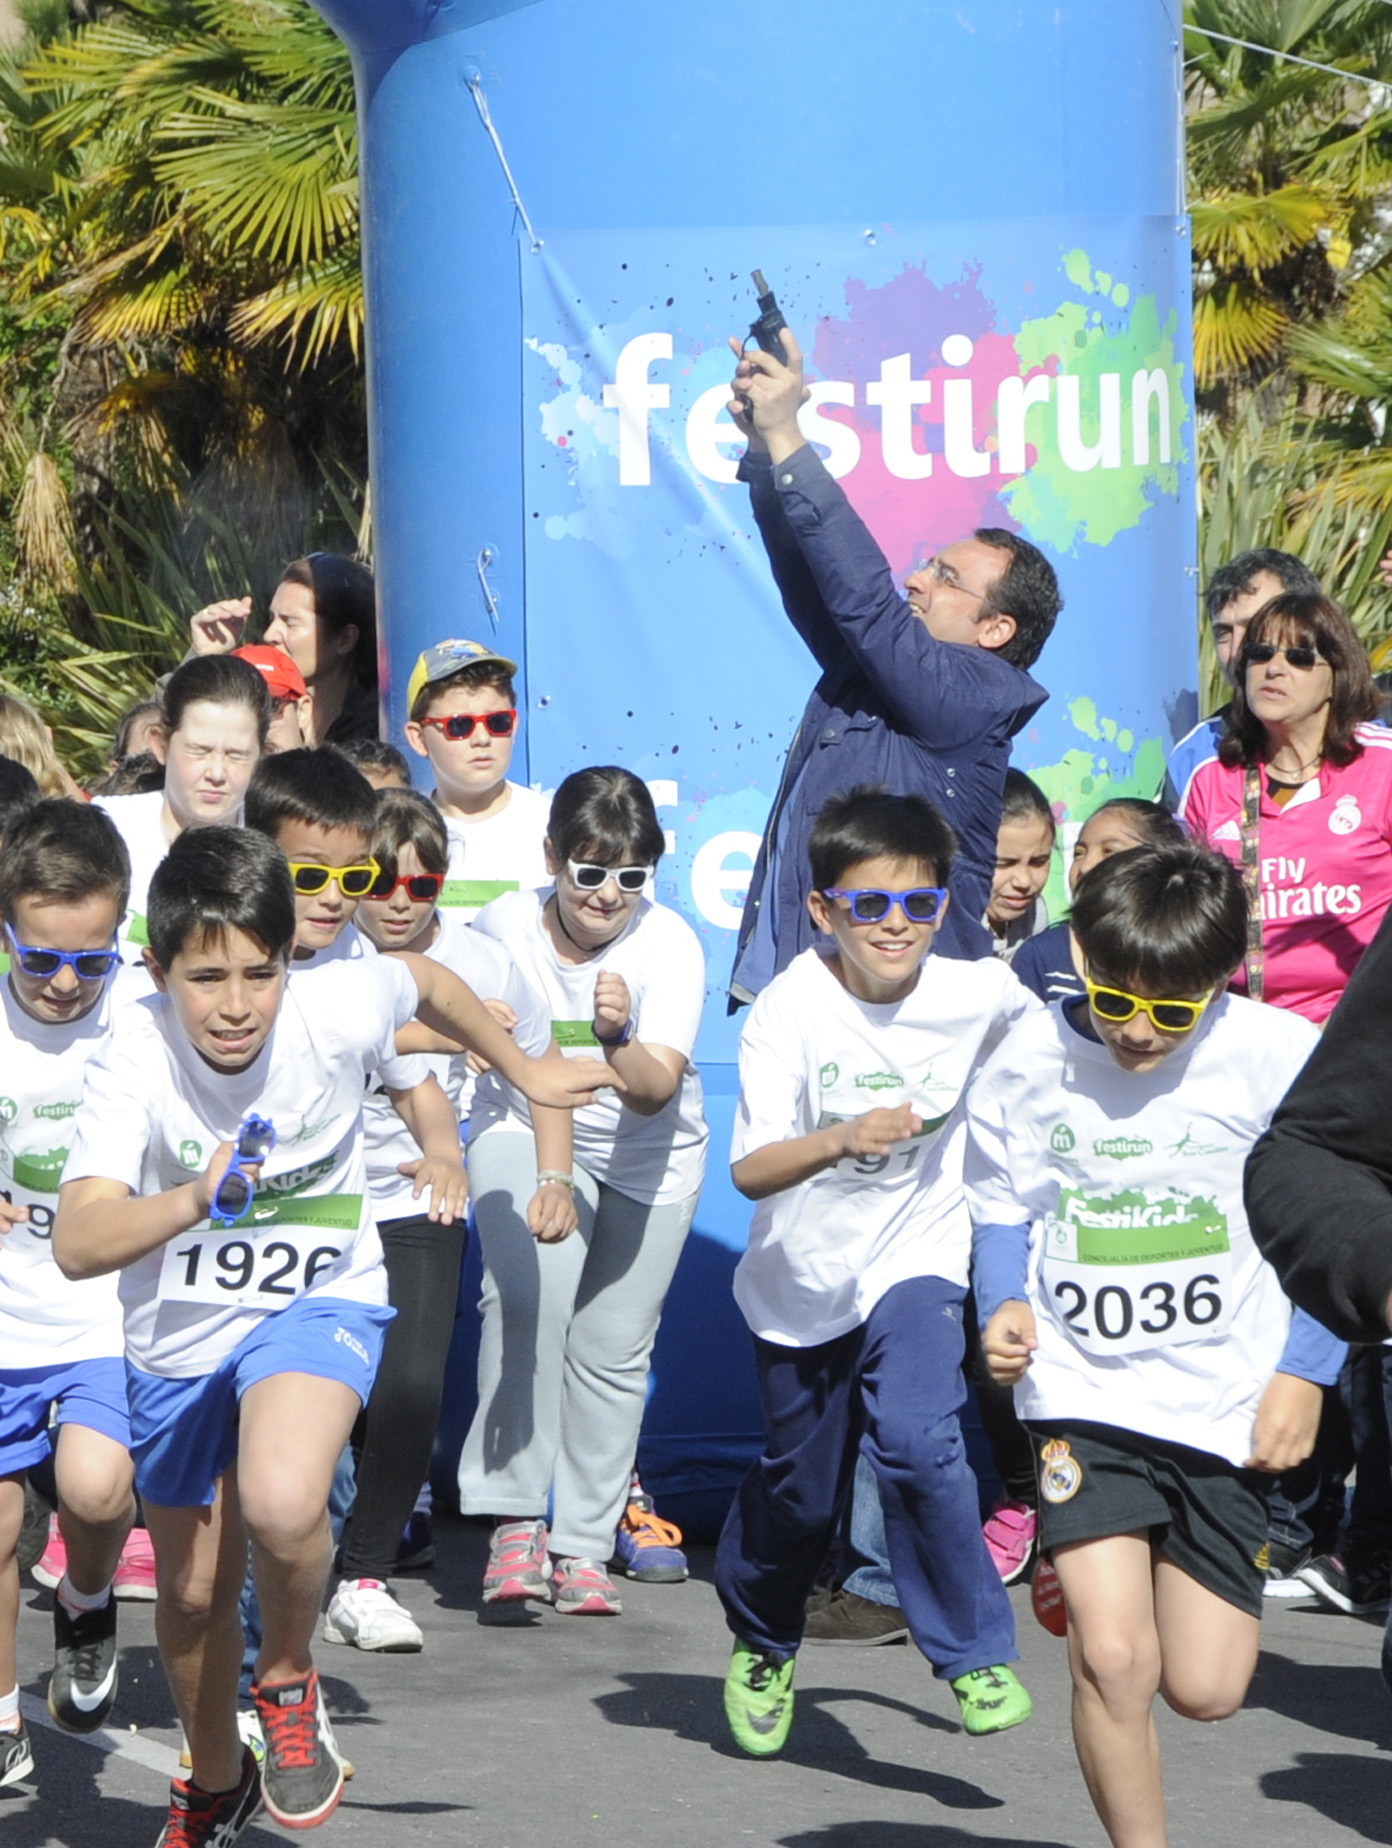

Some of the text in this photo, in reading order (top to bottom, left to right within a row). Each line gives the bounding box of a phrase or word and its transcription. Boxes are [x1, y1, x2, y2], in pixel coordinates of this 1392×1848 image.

[603, 332, 1171, 487] festirun
[1261, 857, 1306, 884] Fly
[1260, 880, 1362, 920] irates
[176, 1241, 342, 1295] 1926
[1054, 1273, 1222, 1340] 2036
